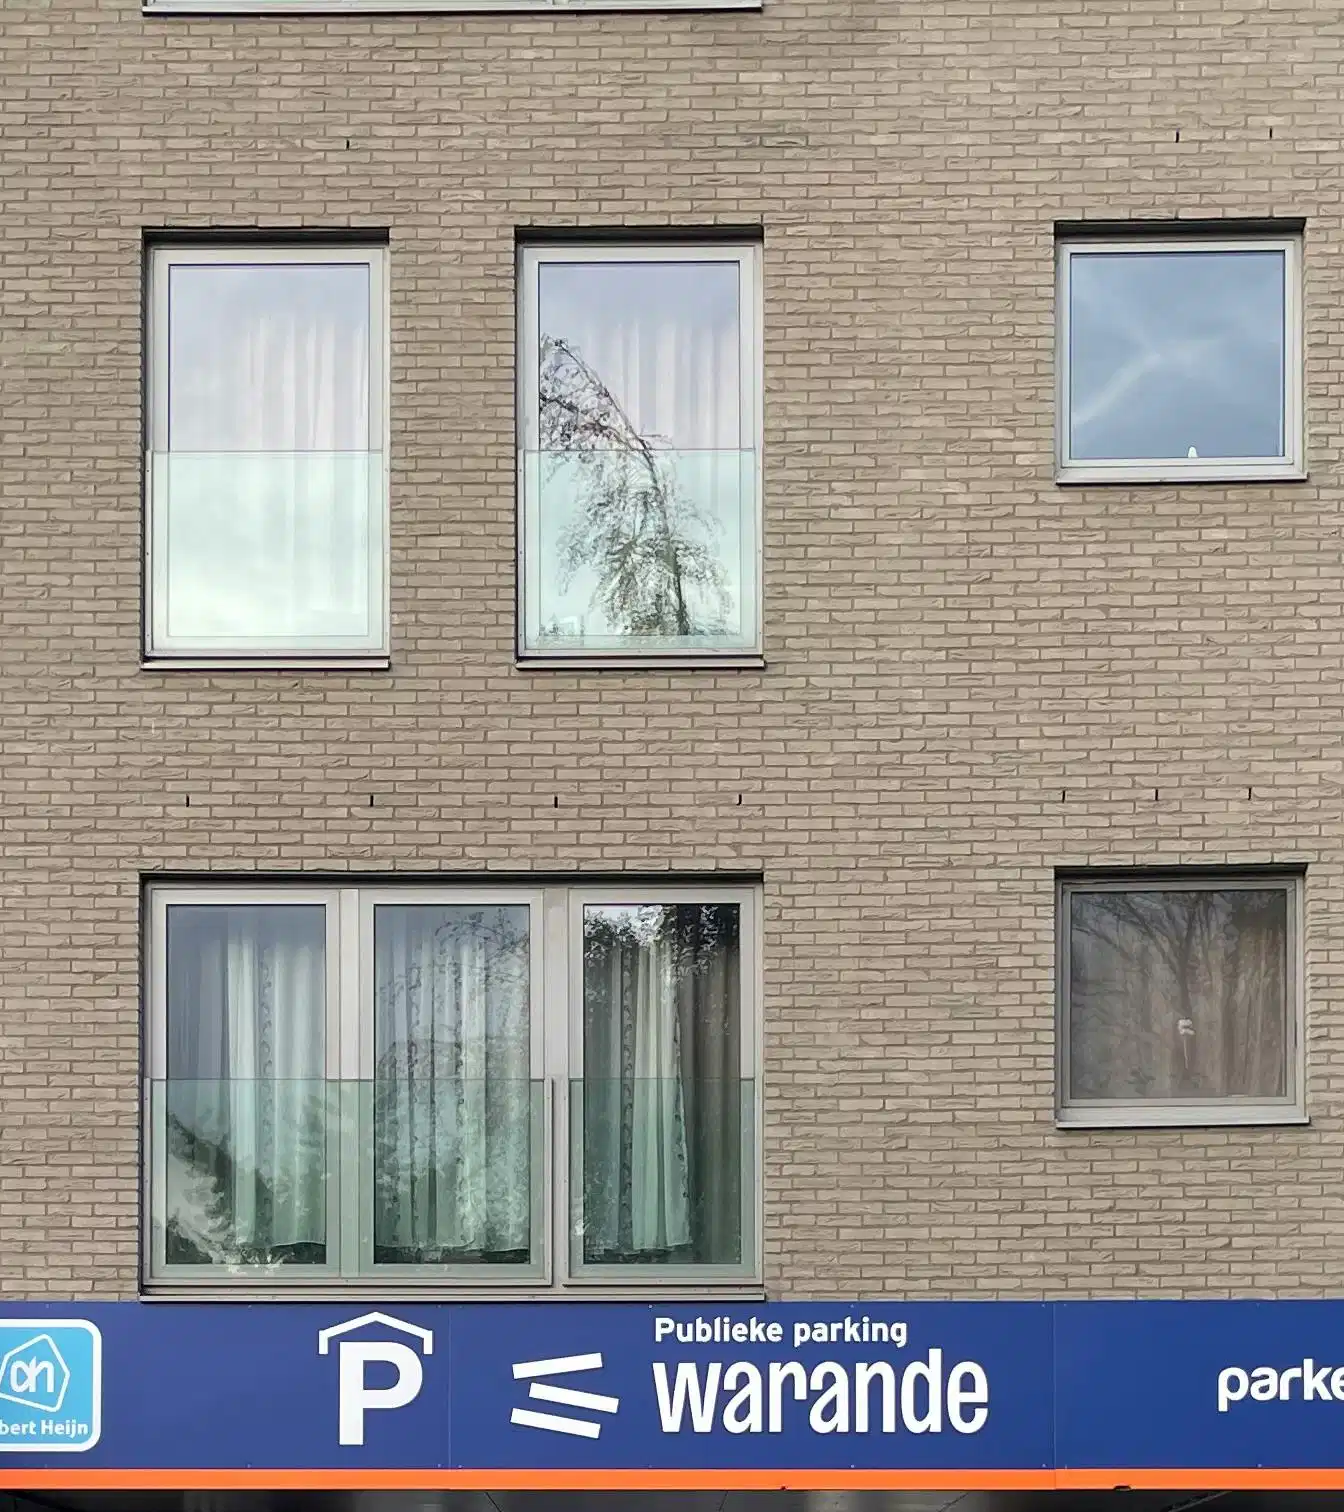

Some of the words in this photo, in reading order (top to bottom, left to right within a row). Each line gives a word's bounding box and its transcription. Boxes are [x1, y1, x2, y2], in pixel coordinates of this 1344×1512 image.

[654, 1317, 783, 1343] Publieke
[794, 1317, 908, 1348] parking
[652, 1348, 989, 1434] warande
[41, 1419, 88, 1439] Heijn
